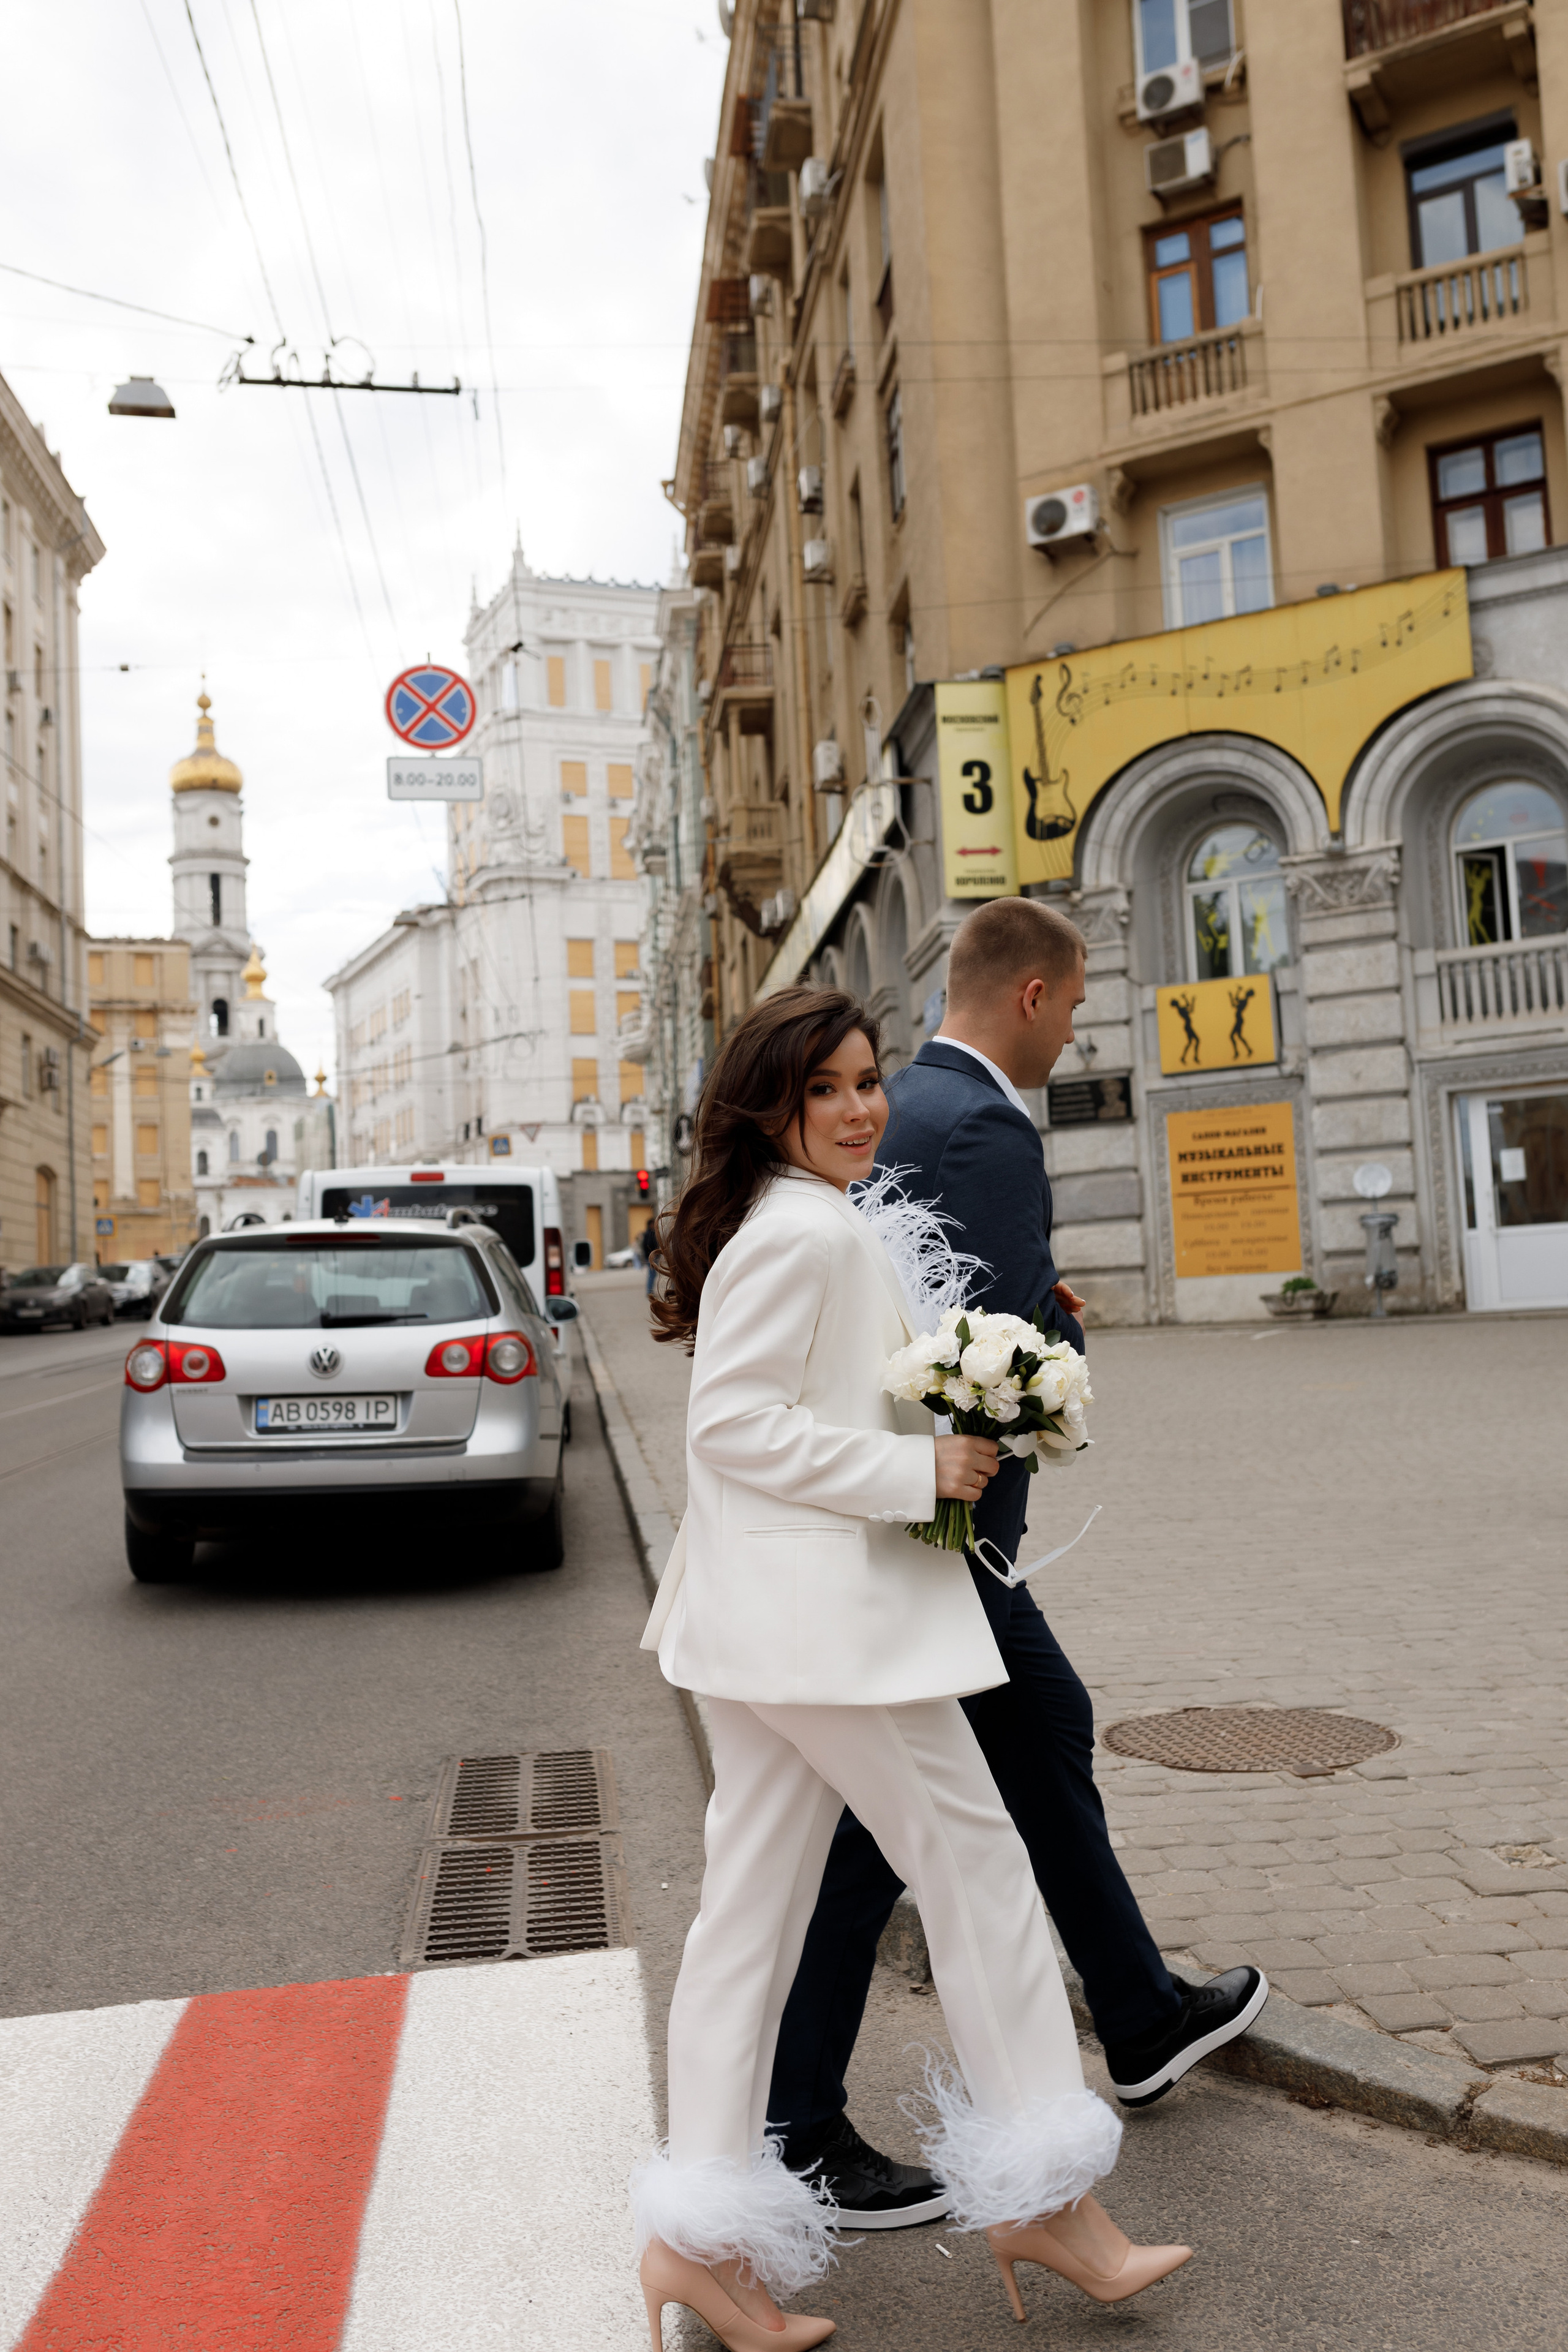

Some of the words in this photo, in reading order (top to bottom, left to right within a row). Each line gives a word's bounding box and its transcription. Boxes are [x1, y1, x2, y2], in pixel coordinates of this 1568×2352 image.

[961, 759, 993, 815] 3
[1177, 1143, 1285, 1164] МУЗЫКАЛЬНЫЕ
[1181, 1164, 1284, 1184] ИНСТРУМЕНТЫ
[270, 1402, 301, 1422] AB
[306, 1401, 356, 1421] 0598
[365, 1400, 390, 1420] IP
